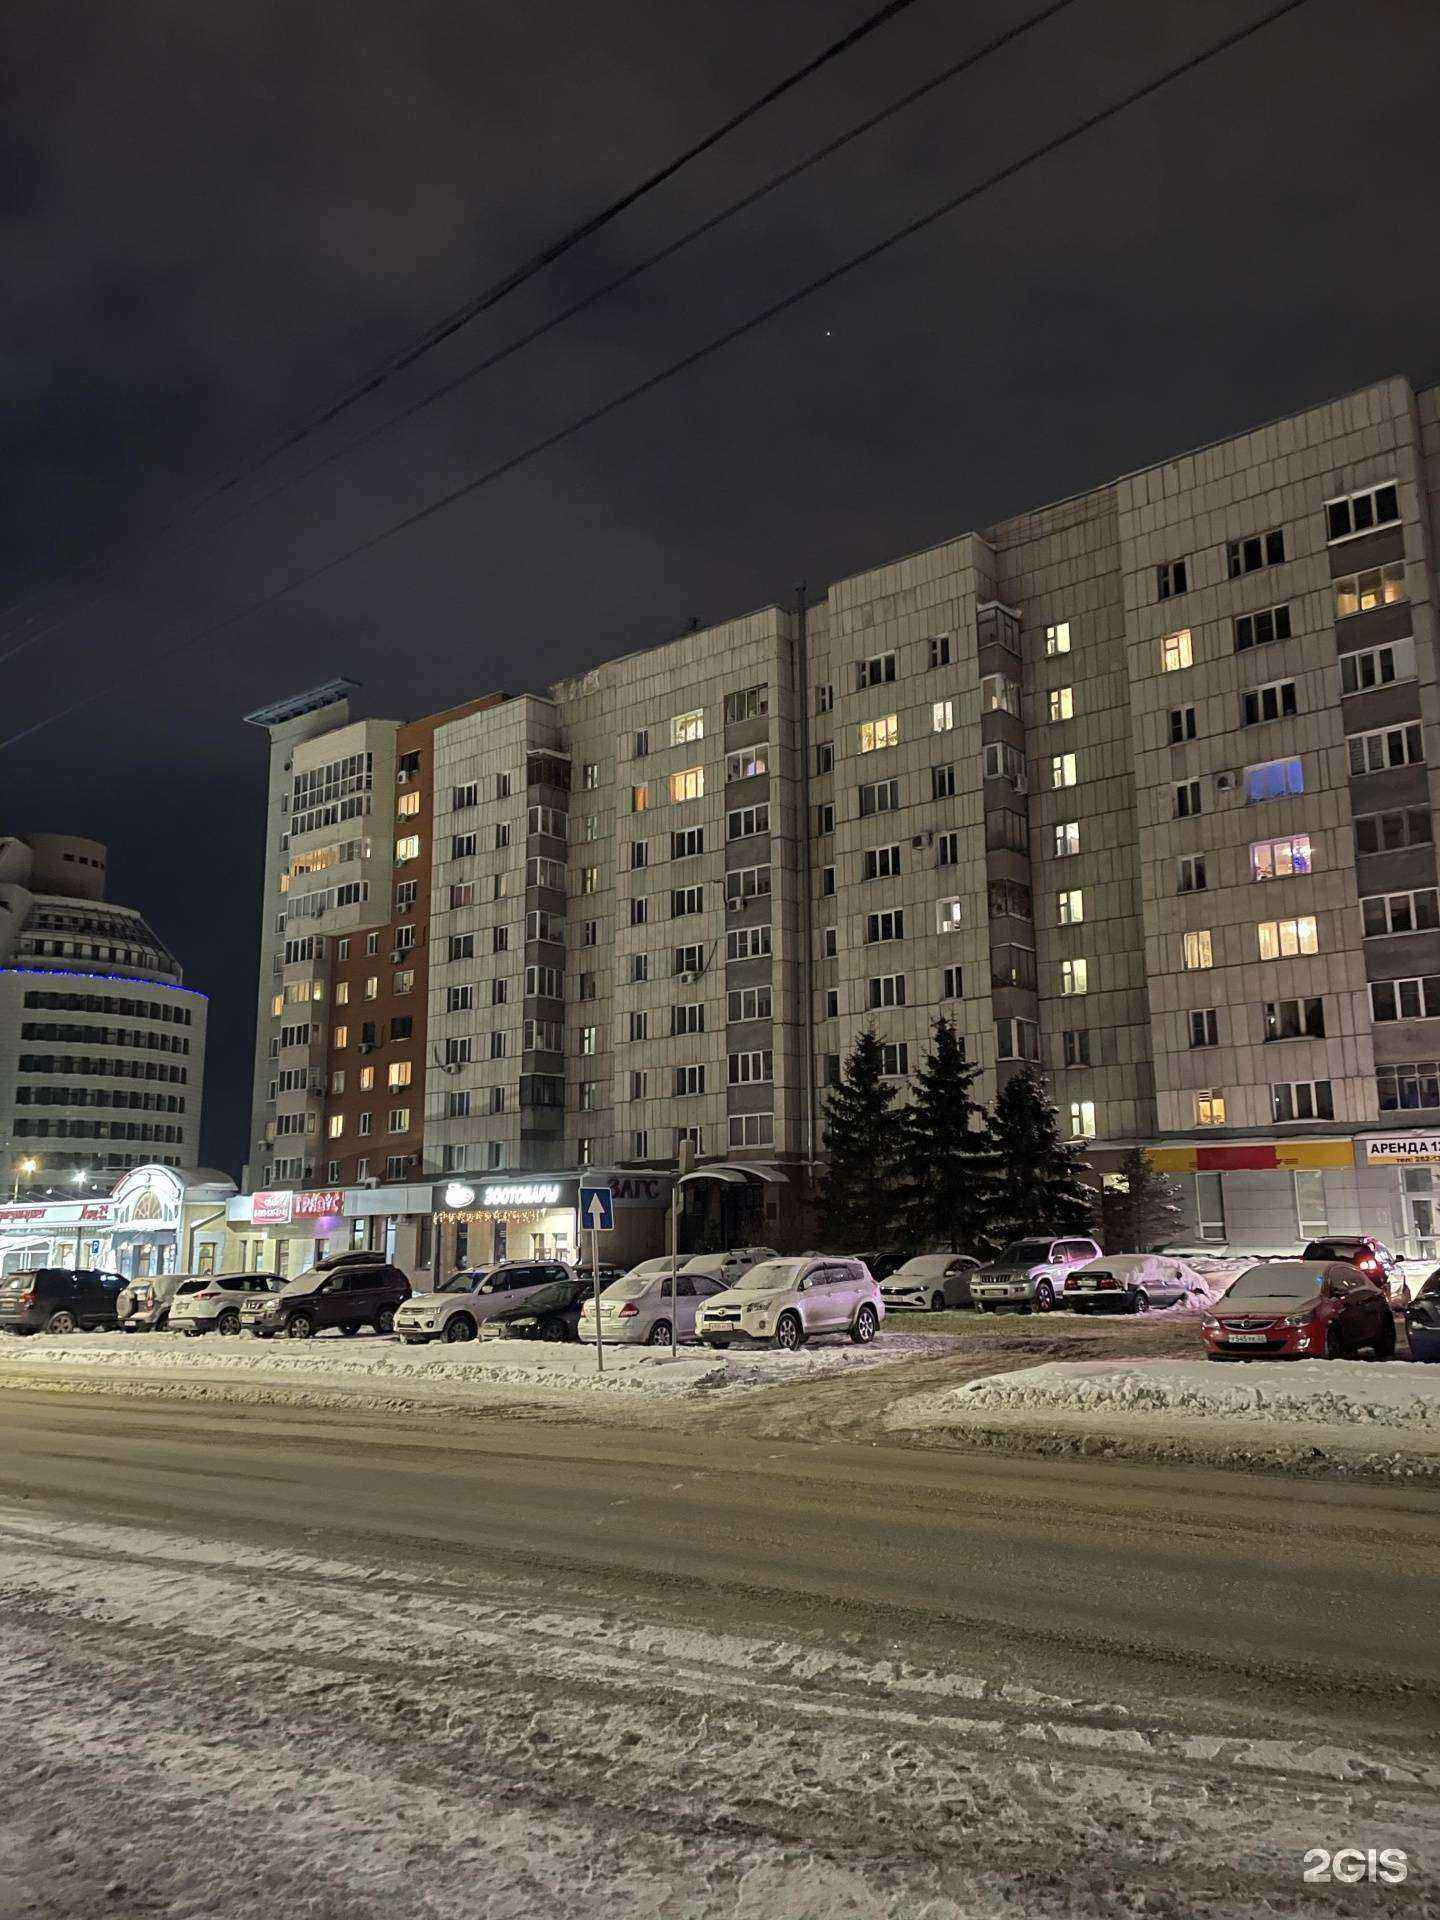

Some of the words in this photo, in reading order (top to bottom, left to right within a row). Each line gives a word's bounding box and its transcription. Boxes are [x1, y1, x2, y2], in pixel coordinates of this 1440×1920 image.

[1371, 1142, 1429, 1154] АРЕНДА
[484, 1184, 560, 1205] ЗООТОВАРЫ
[608, 1178, 659, 1198] ЗАГС
